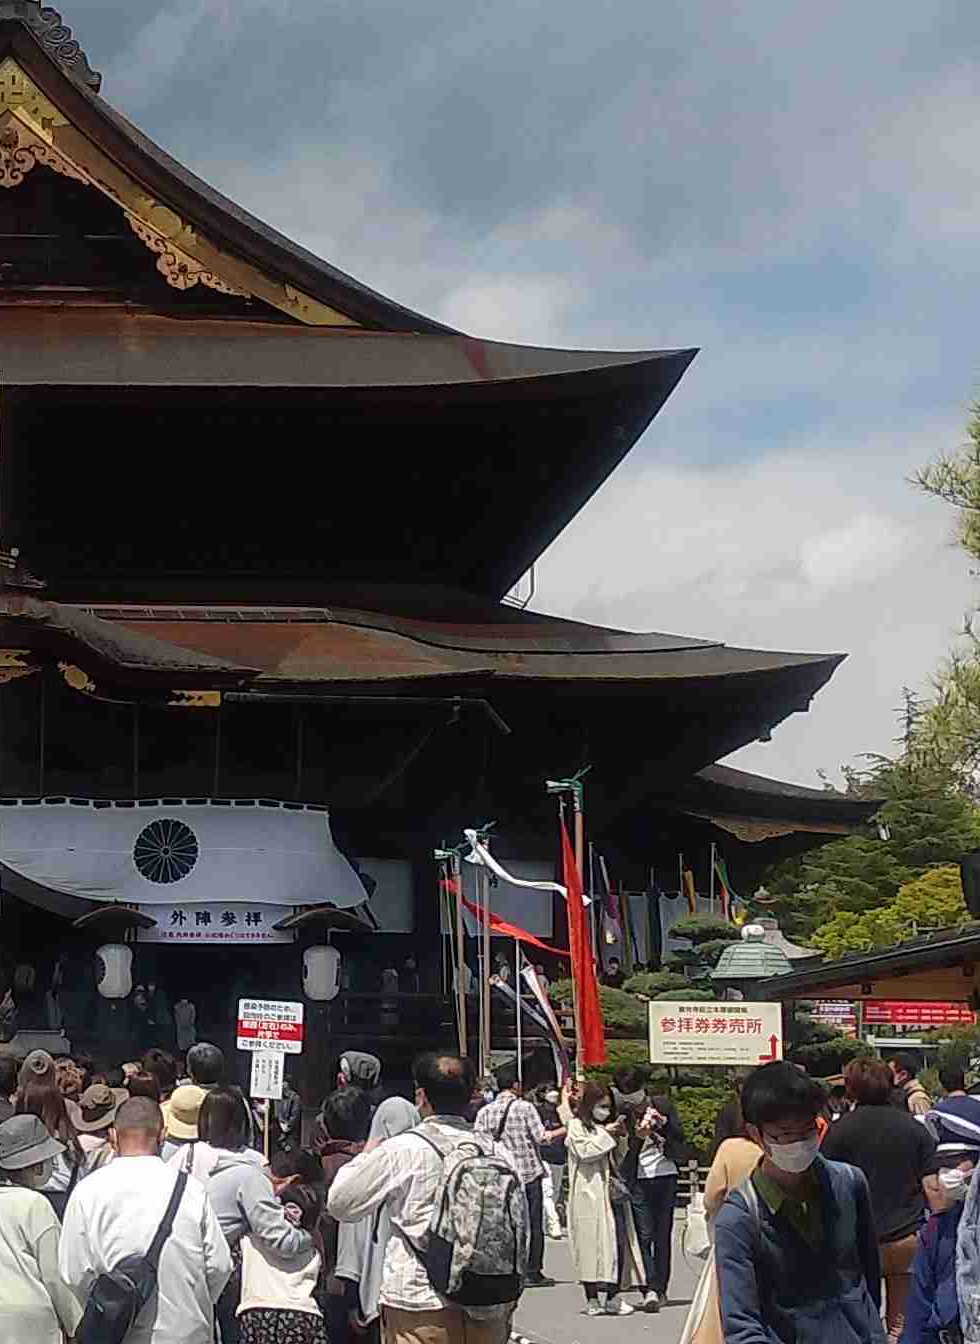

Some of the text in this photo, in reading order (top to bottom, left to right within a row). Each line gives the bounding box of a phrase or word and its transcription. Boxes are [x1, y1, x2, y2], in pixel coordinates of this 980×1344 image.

[660, 1017, 763, 1034] 参拝券券売所
